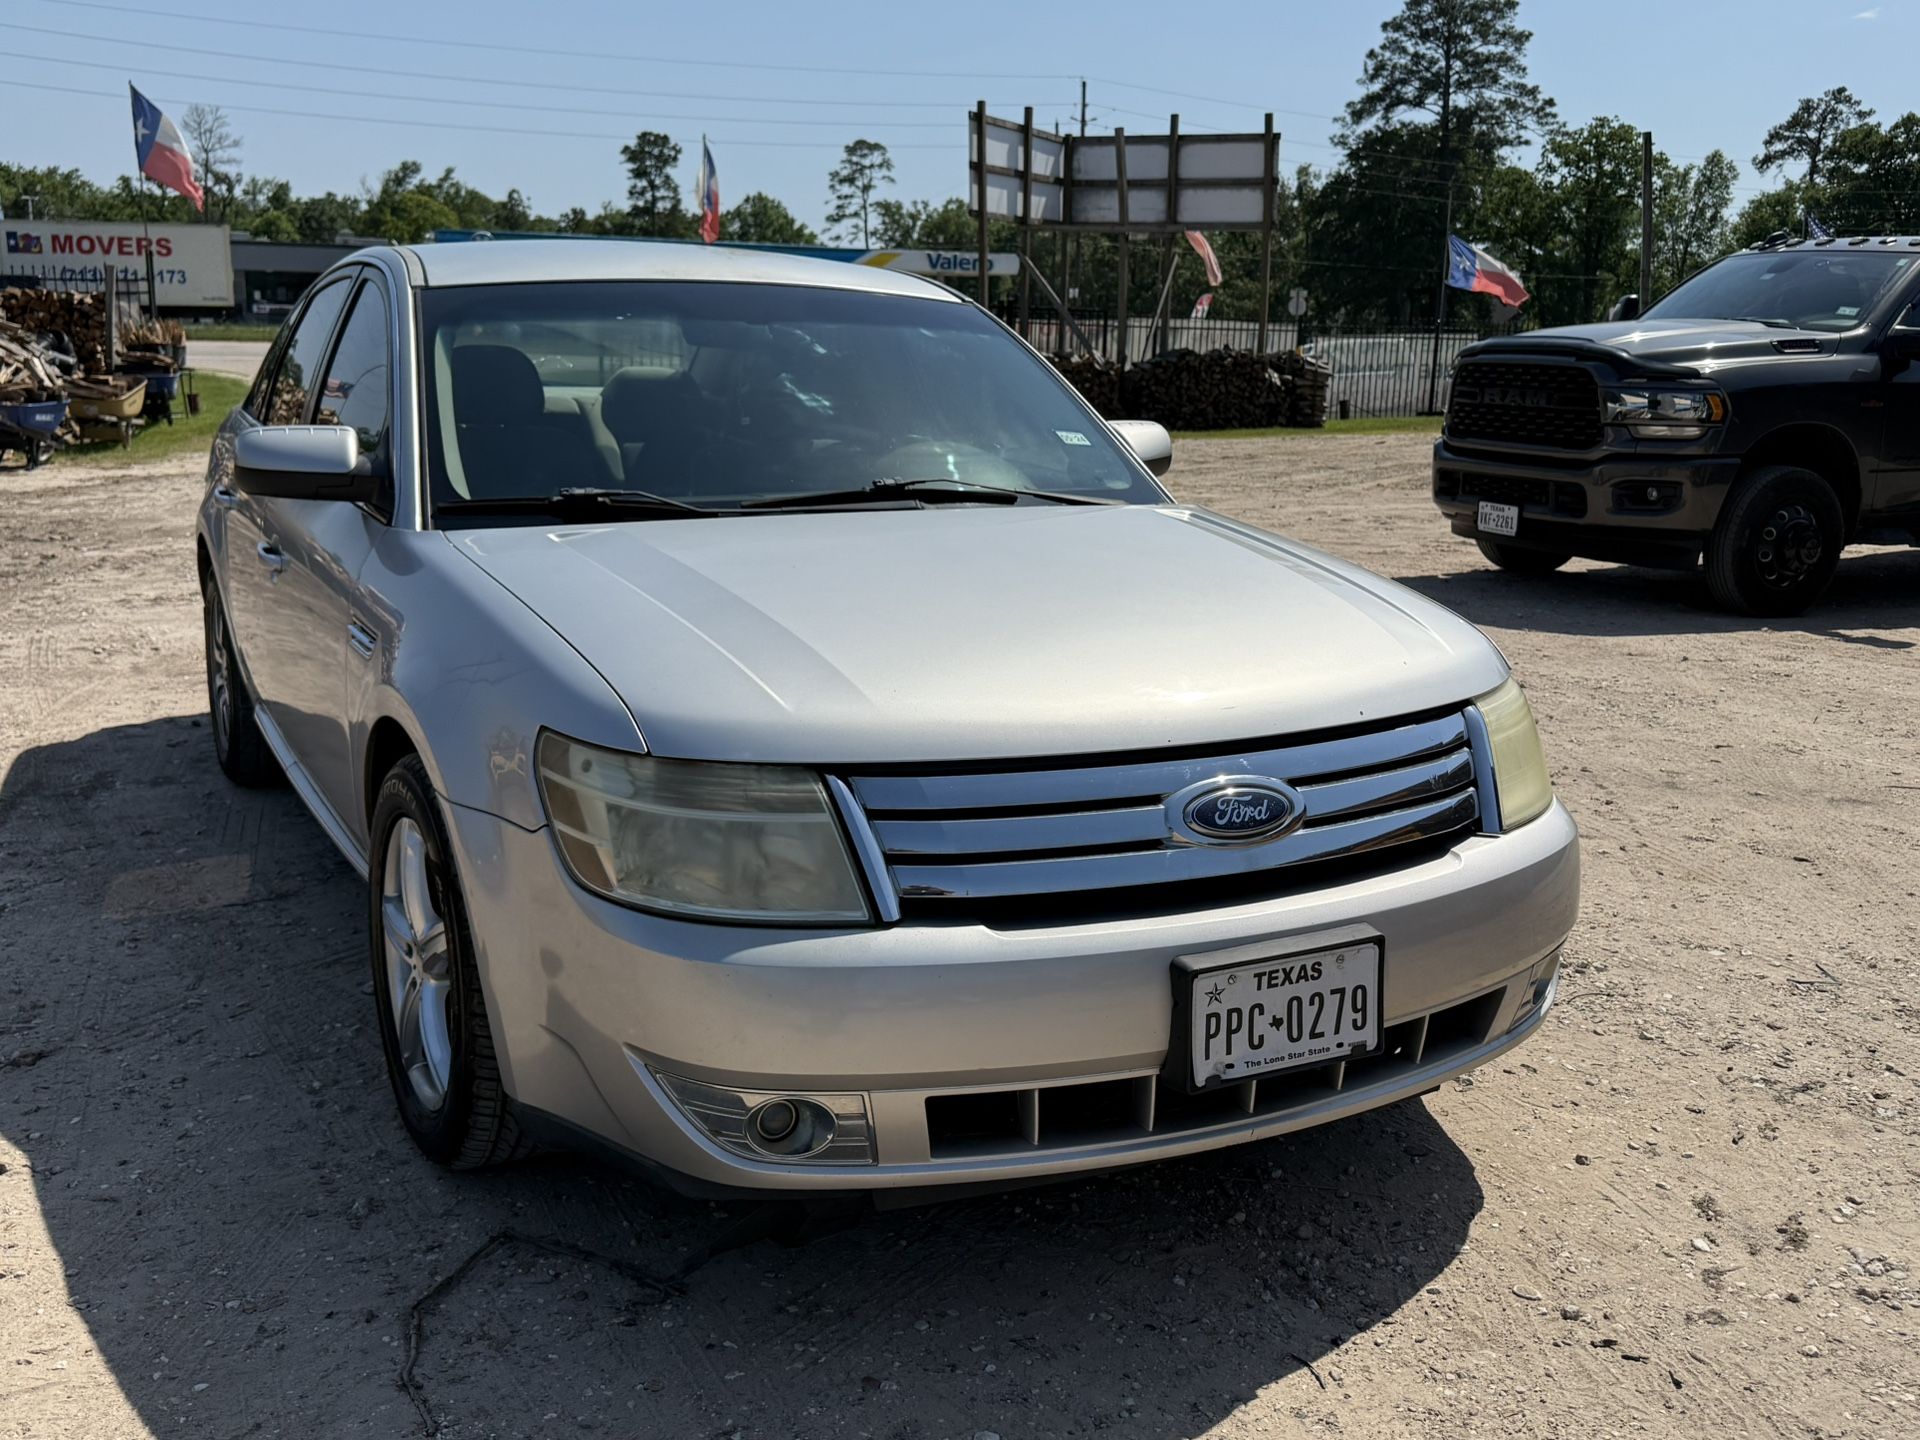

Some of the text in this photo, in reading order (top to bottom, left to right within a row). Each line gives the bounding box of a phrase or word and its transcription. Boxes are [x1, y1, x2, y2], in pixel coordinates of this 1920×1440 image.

[51, 234, 173, 257] MOVERS
[926, 253, 994, 271] Valero
[1214, 795, 1270, 826] Ford
[1253, 961, 1323, 992] TEXAS
[1264, 1055, 1286, 1065] Lone
[1288, 1051, 1306, 1060] Star
[1308, 1046, 1331, 1056] State
